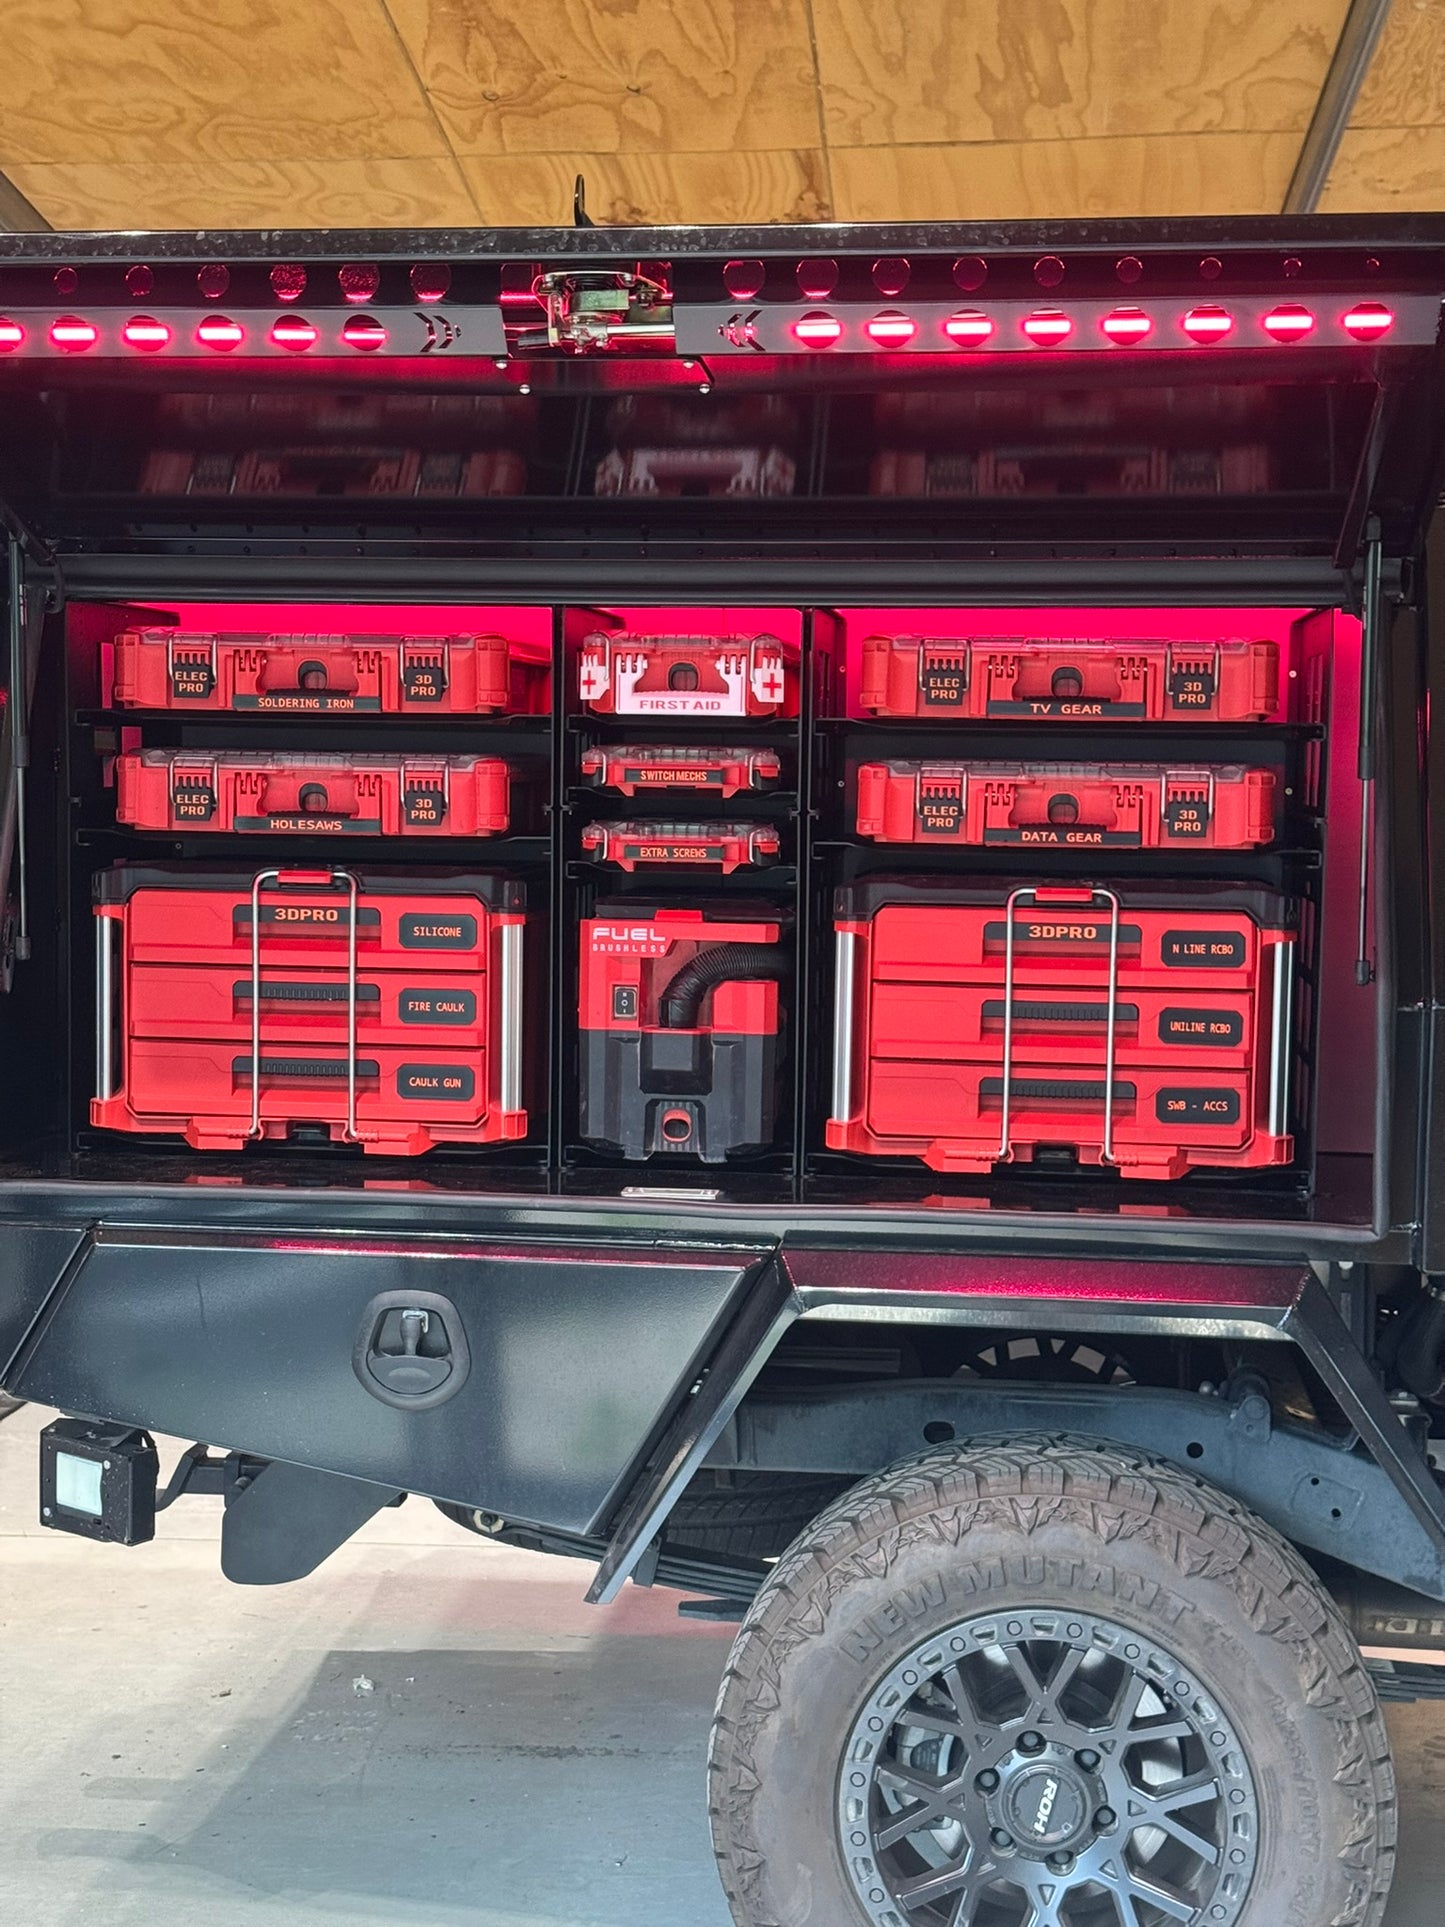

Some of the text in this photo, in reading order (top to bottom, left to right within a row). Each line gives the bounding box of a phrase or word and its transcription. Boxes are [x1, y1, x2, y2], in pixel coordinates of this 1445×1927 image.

[175, 671, 208, 682] ELEC
[415, 674, 433, 684] 3D
[178, 683, 204, 693] PRO
[929, 677, 960, 688] ELEC
[1183, 681, 1202, 692] 3D
[410, 686, 436, 696] PRO
[931, 689, 958, 700] PRO
[258, 697, 354, 709] SOLDERING IRON
[1178, 693, 1206, 704] PRO
[640, 699, 721, 711] FIRST AID
[1030, 703, 1102, 715] TV GEAR
[640, 770, 707, 781] SWITCH MECHS
[176, 794, 209, 804] ELEC
[415, 798, 433, 809] 3D
[180, 805, 205, 816] PRO
[411, 810, 436, 820] PRO
[923, 805, 959, 816] ELEC
[1179, 809, 1198, 820] 3D
[270, 819, 342, 831] HOLESAWS
[927, 818, 954, 828] PRO
[1174, 821, 1201, 832] PRO
[1021, 831, 1102, 843] DATA GEAR
[640, 847, 669, 857] EXTRA
[274, 908, 339, 922] 3DPRO
[413, 926, 462, 937] SILICONE
[592, 927, 666, 941] FUEL
[1028, 925, 1097, 939] 3DPRO
[592, 944, 666, 953] BRUSHLESS
[1172, 944, 1233, 955] N LINE RCBO
[408, 1001, 465, 1012] FIRE CAULK
[1170, 1021, 1231, 1034] UNILINE RCBO
[409, 1077, 461, 1088] CAULK GUN
[1203, 1101, 1228, 1111] ACCS
[840, 1571, 948, 1664] NEW
[956, 1554, 1197, 1625] MUTANT
[1033, 1778, 1058, 1834] ROH
